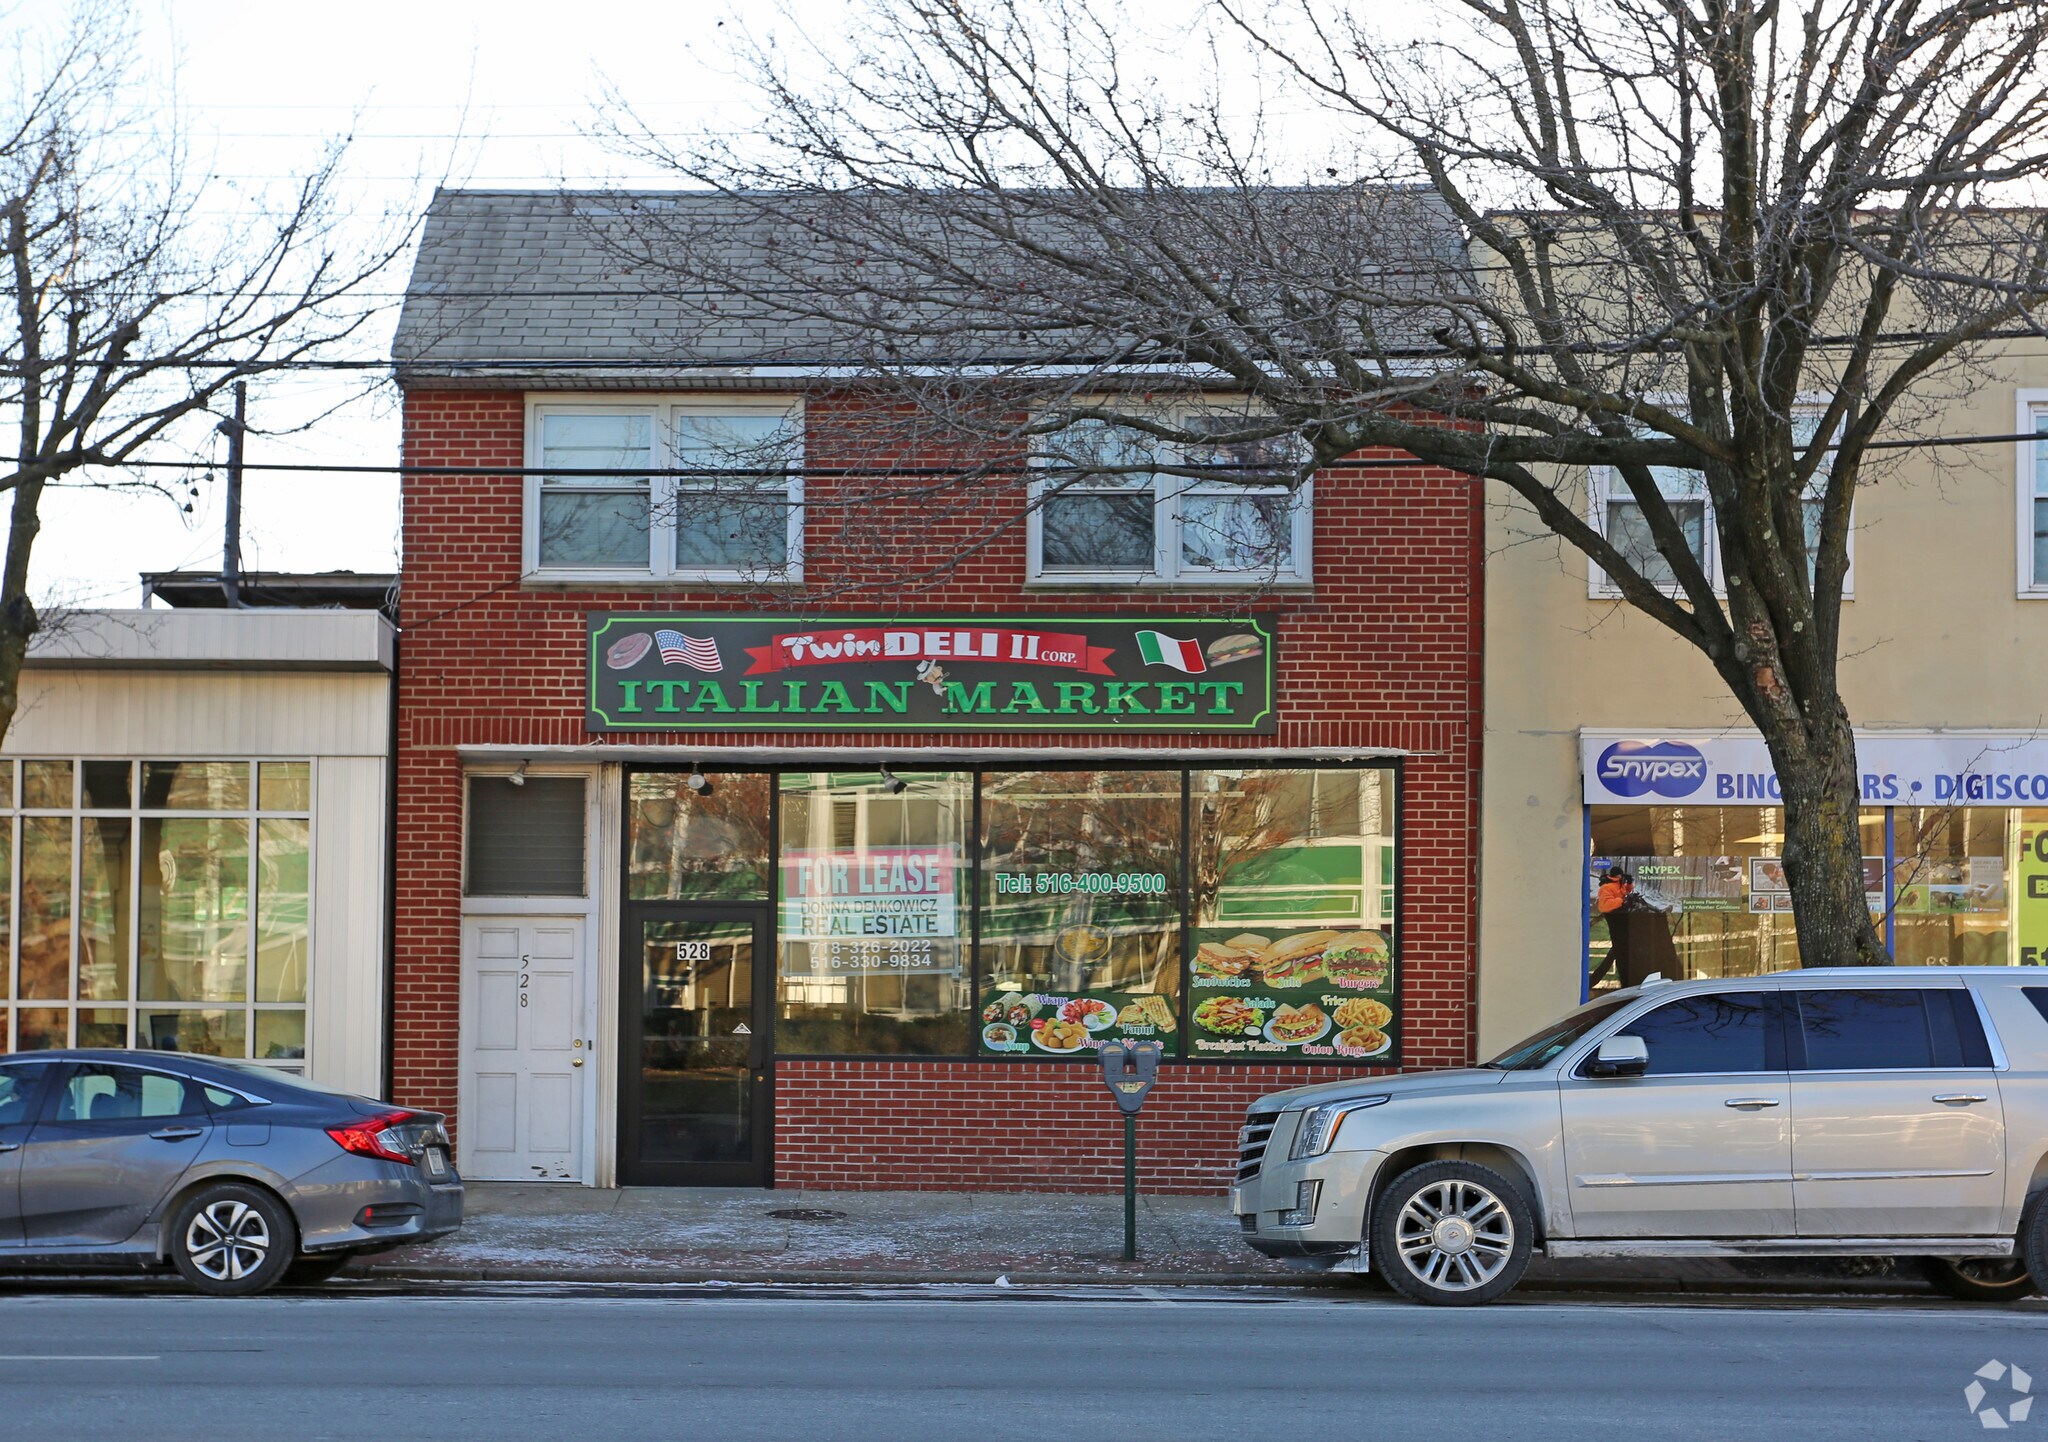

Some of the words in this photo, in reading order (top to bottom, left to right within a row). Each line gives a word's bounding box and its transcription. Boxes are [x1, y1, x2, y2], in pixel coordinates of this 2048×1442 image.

[781, 633, 881, 660] Twin
[884, 631, 998, 657] DELI
[1041, 650, 1077, 663] CORP.
[618, 681, 914, 713] ITALIAN
[941, 681, 1244, 714] MARKET
[1601, 755, 1703, 782] Snypex
[799, 856, 849, 895] FOR
[859, 853, 940, 893] LEASE
[1638, 865, 1681, 874] SNYPEX
[996, 873, 1032, 893] Tel:
[1036, 873, 1166, 894] 516-400-9500
[801, 900, 851, 915] DONNA
[854, 898, 938, 914] DEMKOWICZ
[801, 915, 857, 935] REAL
[863, 914, 938, 935] ESTATE
[678, 943, 709, 959] 528
[1192, 975, 1251, 988] Sandwiches
[1277, 976, 1302, 989] Subs
[1337, 977, 1379, 991] Burgers
[1034, 994, 1068, 1008] Wraps
[1243, 996, 1276, 1009] Salads
[1320, 994, 1348, 1006] Fries
[1122, 1024, 1155, 1035] Panini
[1004, 1041, 1030, 1053] Soup
[1195, 1038, 1245, 1053] Breakfast
[1247, 1039, 1287, 1052] Platters
[1301, 1043, 1333, 1056] Onion
[1336, 1042, 1366, 1057] Rings
